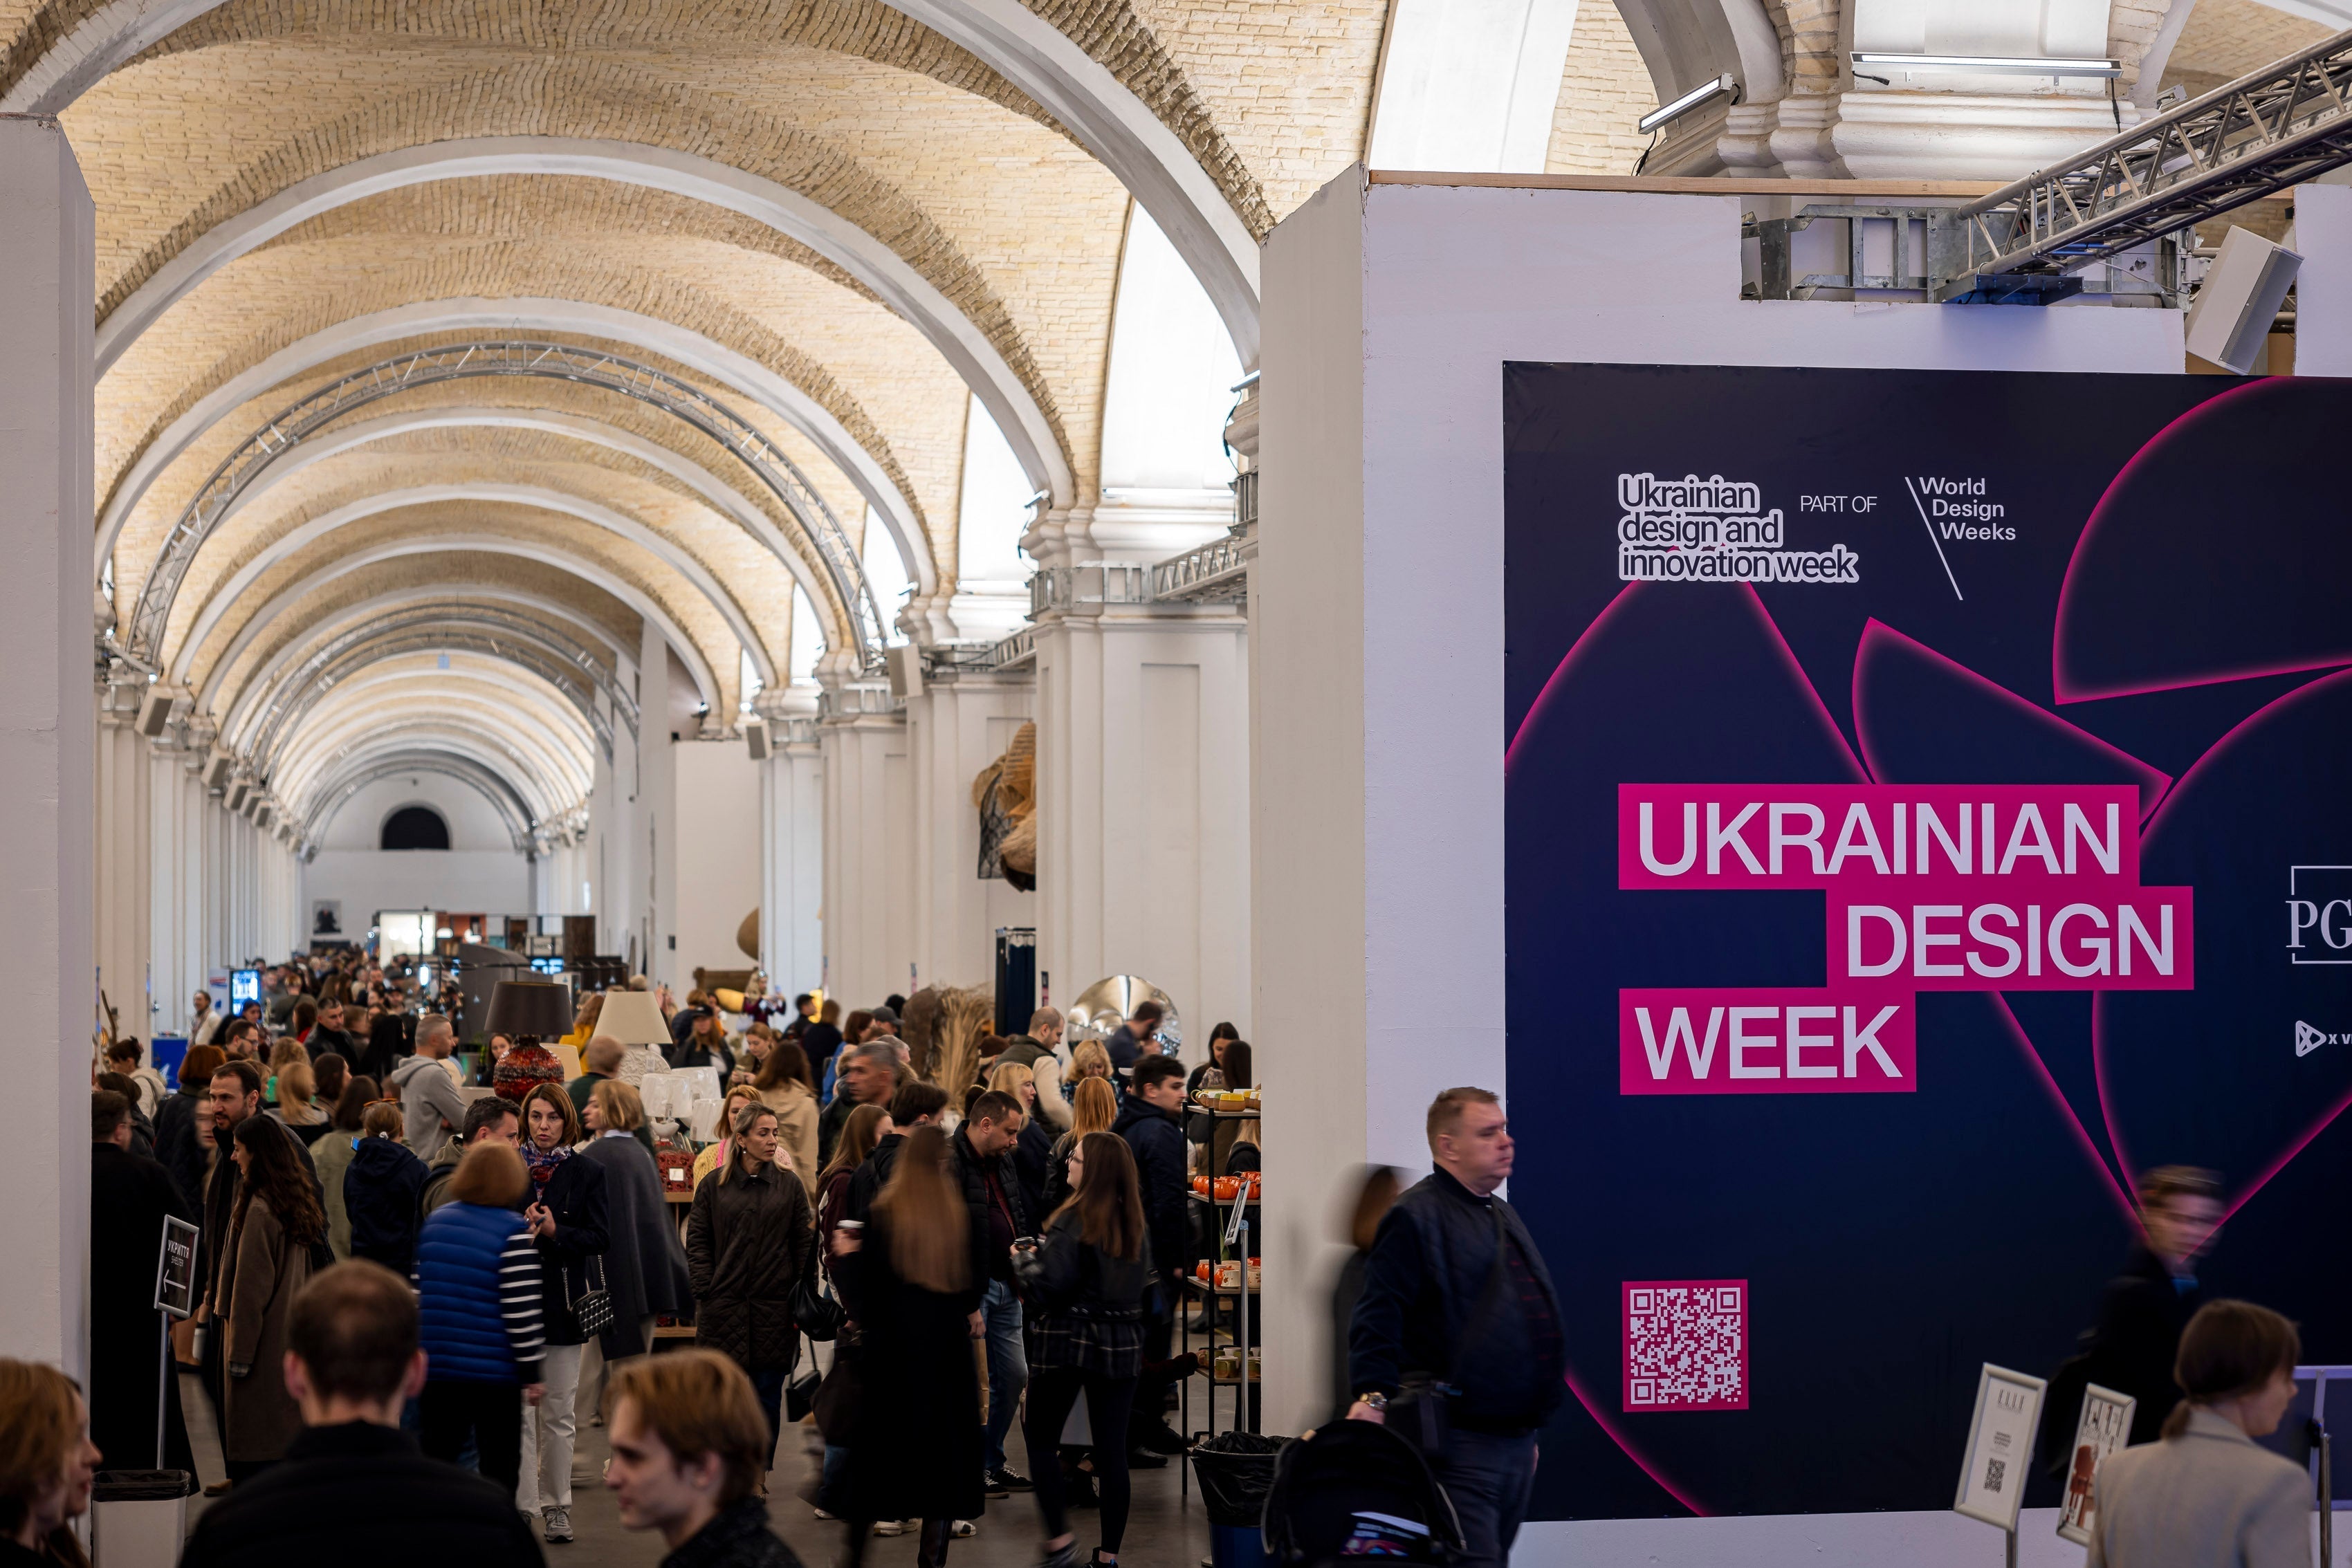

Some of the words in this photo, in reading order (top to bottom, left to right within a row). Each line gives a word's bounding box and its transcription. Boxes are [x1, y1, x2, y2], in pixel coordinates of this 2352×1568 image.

[1622, 477, 1756, 508] Ukrainian
[1919, 477, 1985, 495] World
[1801, 495, 1848, 513] PART
[1852, 496, 1877, 513] OF
[1932, 499, 2005, 519] Design
[1621, 513, 1718, 549] design
[1725, 514, 1779, 544] and
[1939, 522, 2016, 541] Weeks
[1623, 548, 1771, 578] innovation
[1776, 548, 1855, 580] week
[1639, 802, 2120, 876] UKRAINIAN
[1848, 903, 2174, 978] DESIGN
[1635, 1006, 1904, 1080] WEEK
[2342, 1033, 2352, 1044] V
[167, 1239, 190, 1259] УКРИТТЯ
[171, 1255, 184, 1267] SHELTER
